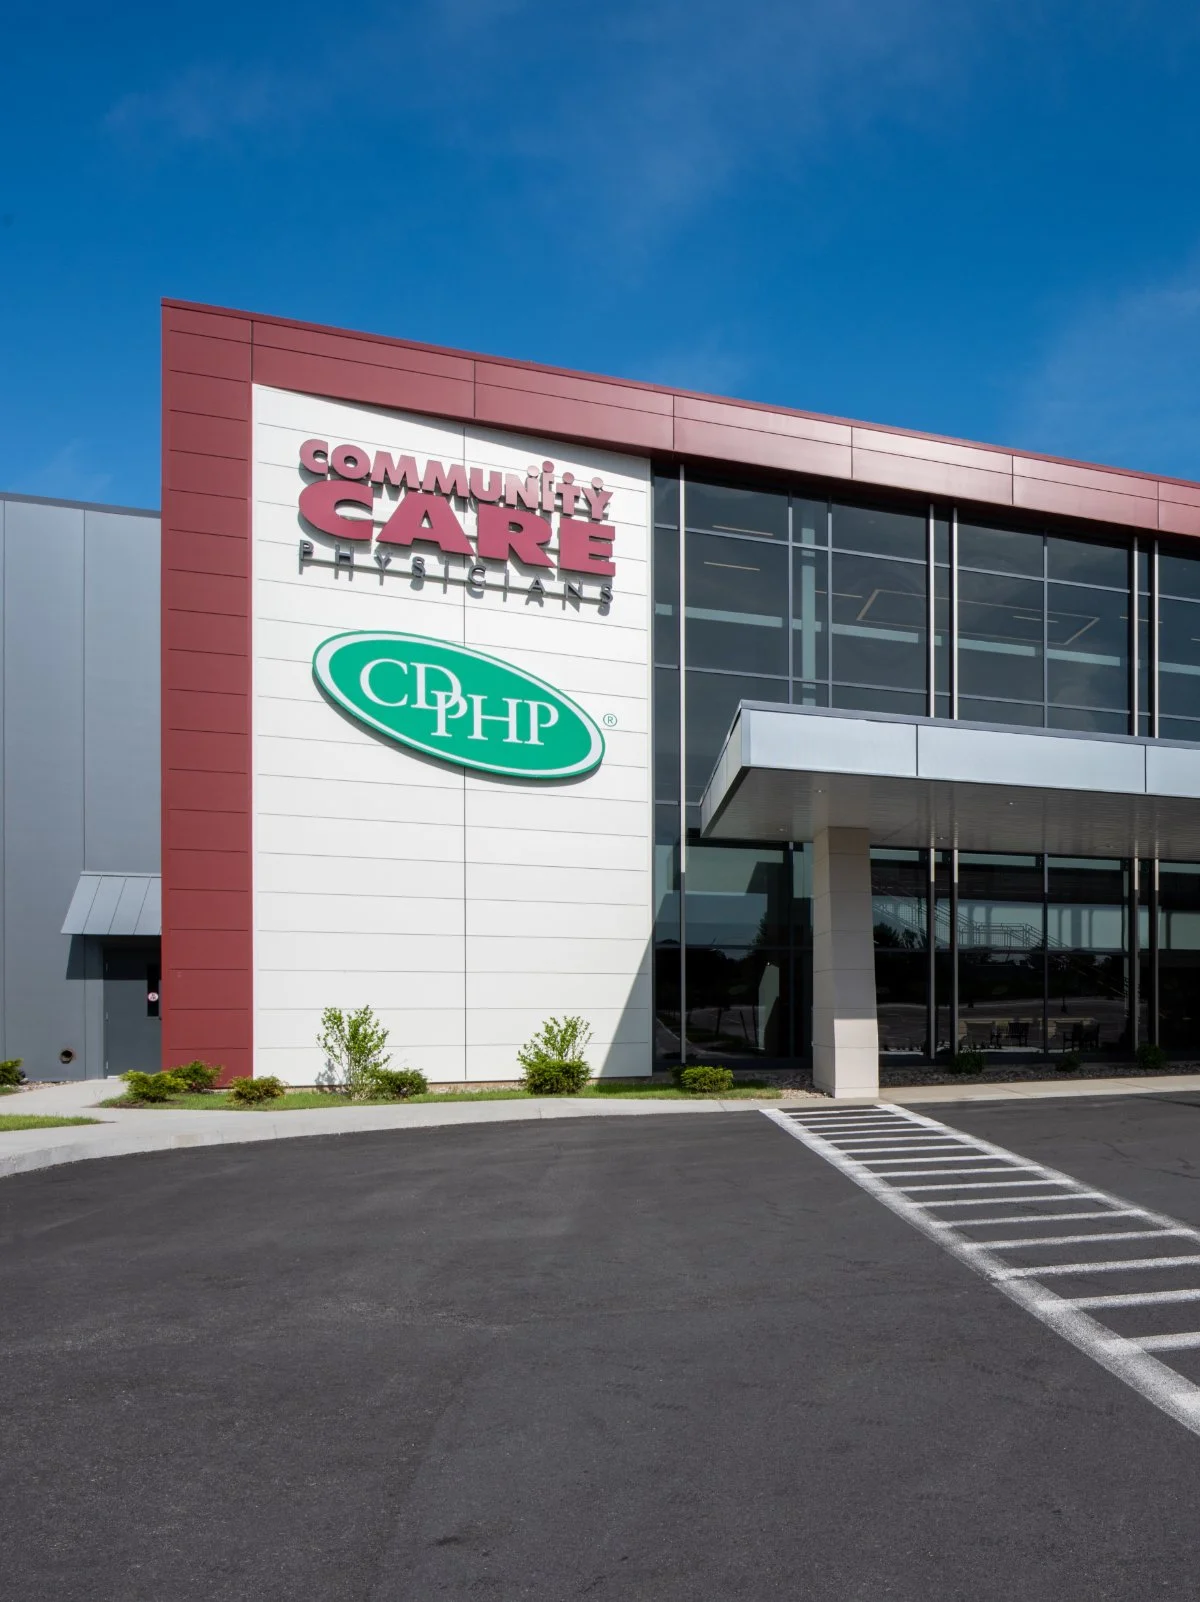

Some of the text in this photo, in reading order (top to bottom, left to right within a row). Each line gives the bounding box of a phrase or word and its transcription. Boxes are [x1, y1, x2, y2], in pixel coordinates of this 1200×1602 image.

[299, 438, 614, 521] COMMUNITY
[298, 479, 616, 577] CARE
[299, 539, 614, 604] PHYSICIANS
[359, 657, 559, 746] CDPHP
